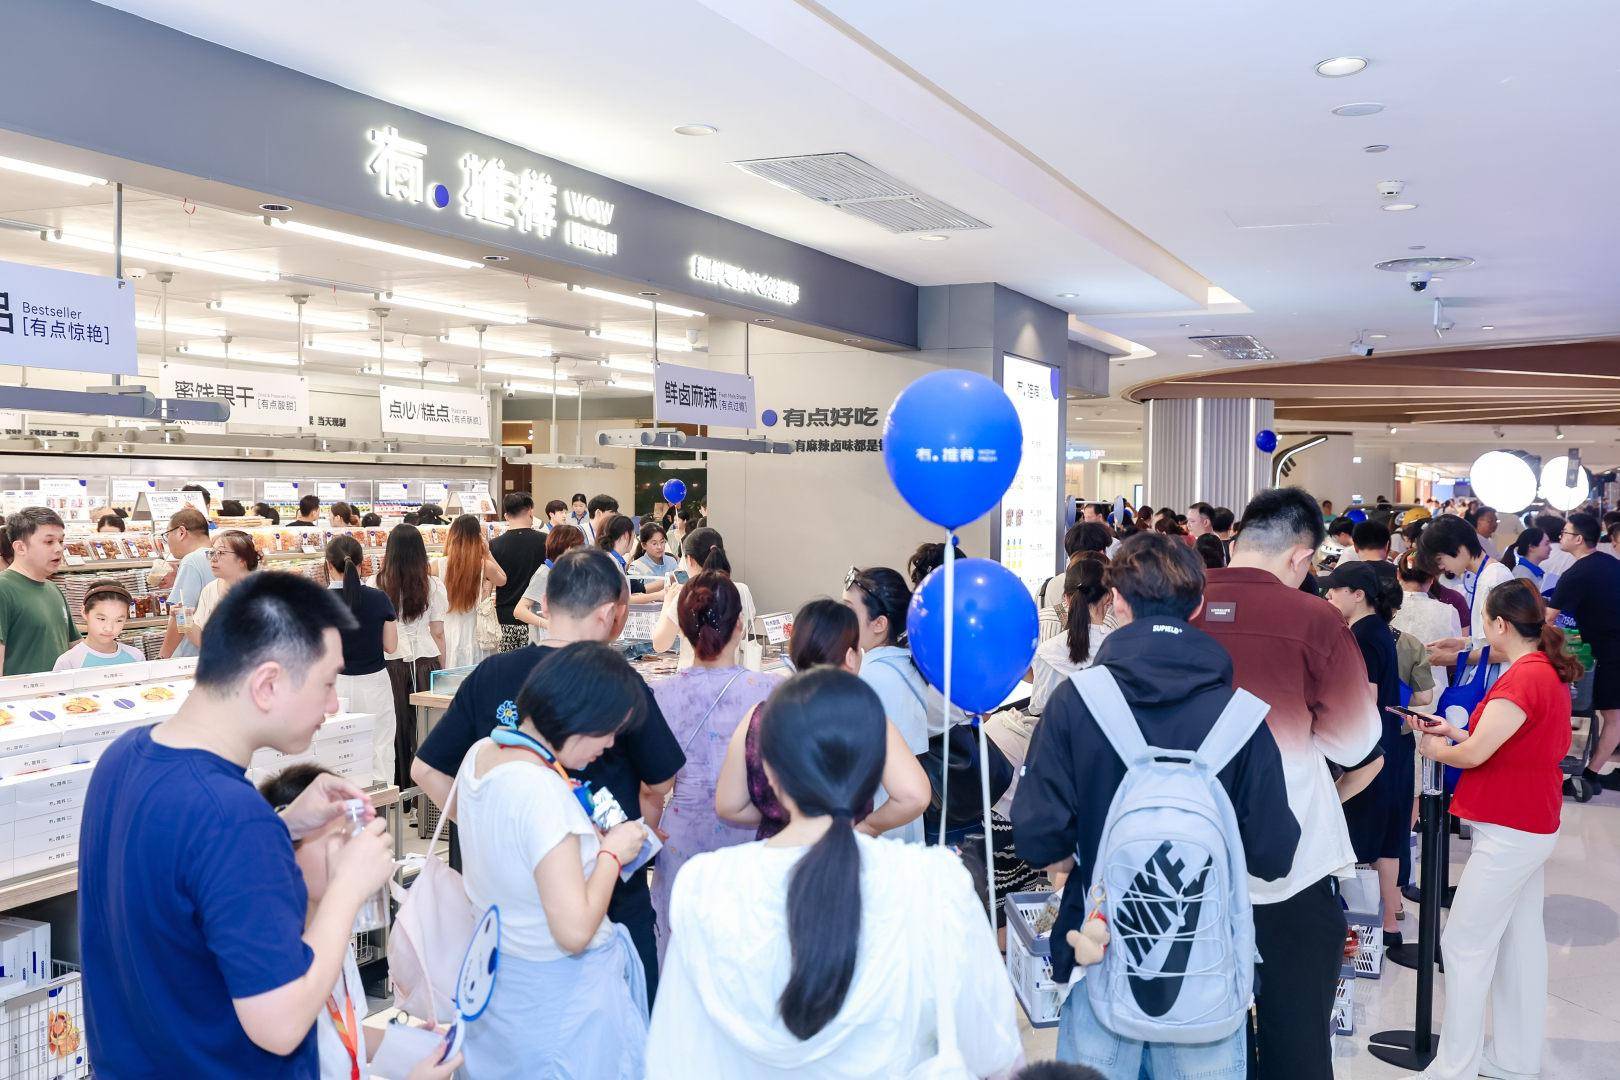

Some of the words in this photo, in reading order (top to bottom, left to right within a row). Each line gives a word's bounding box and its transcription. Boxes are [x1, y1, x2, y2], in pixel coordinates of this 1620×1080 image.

[565, 190, 615, 226] WOW
[22, 301, 82, 320] Bestseller
[23, 316, 110, 345] [有点惊艳]
[664, 380, 718, 410] 鲜卤麻辣
[389, 399, 451, 423] 点心/糕点
[783, 407, 879, 428] 有点好吃
[1113, 840, 1199, 967] NIKE
